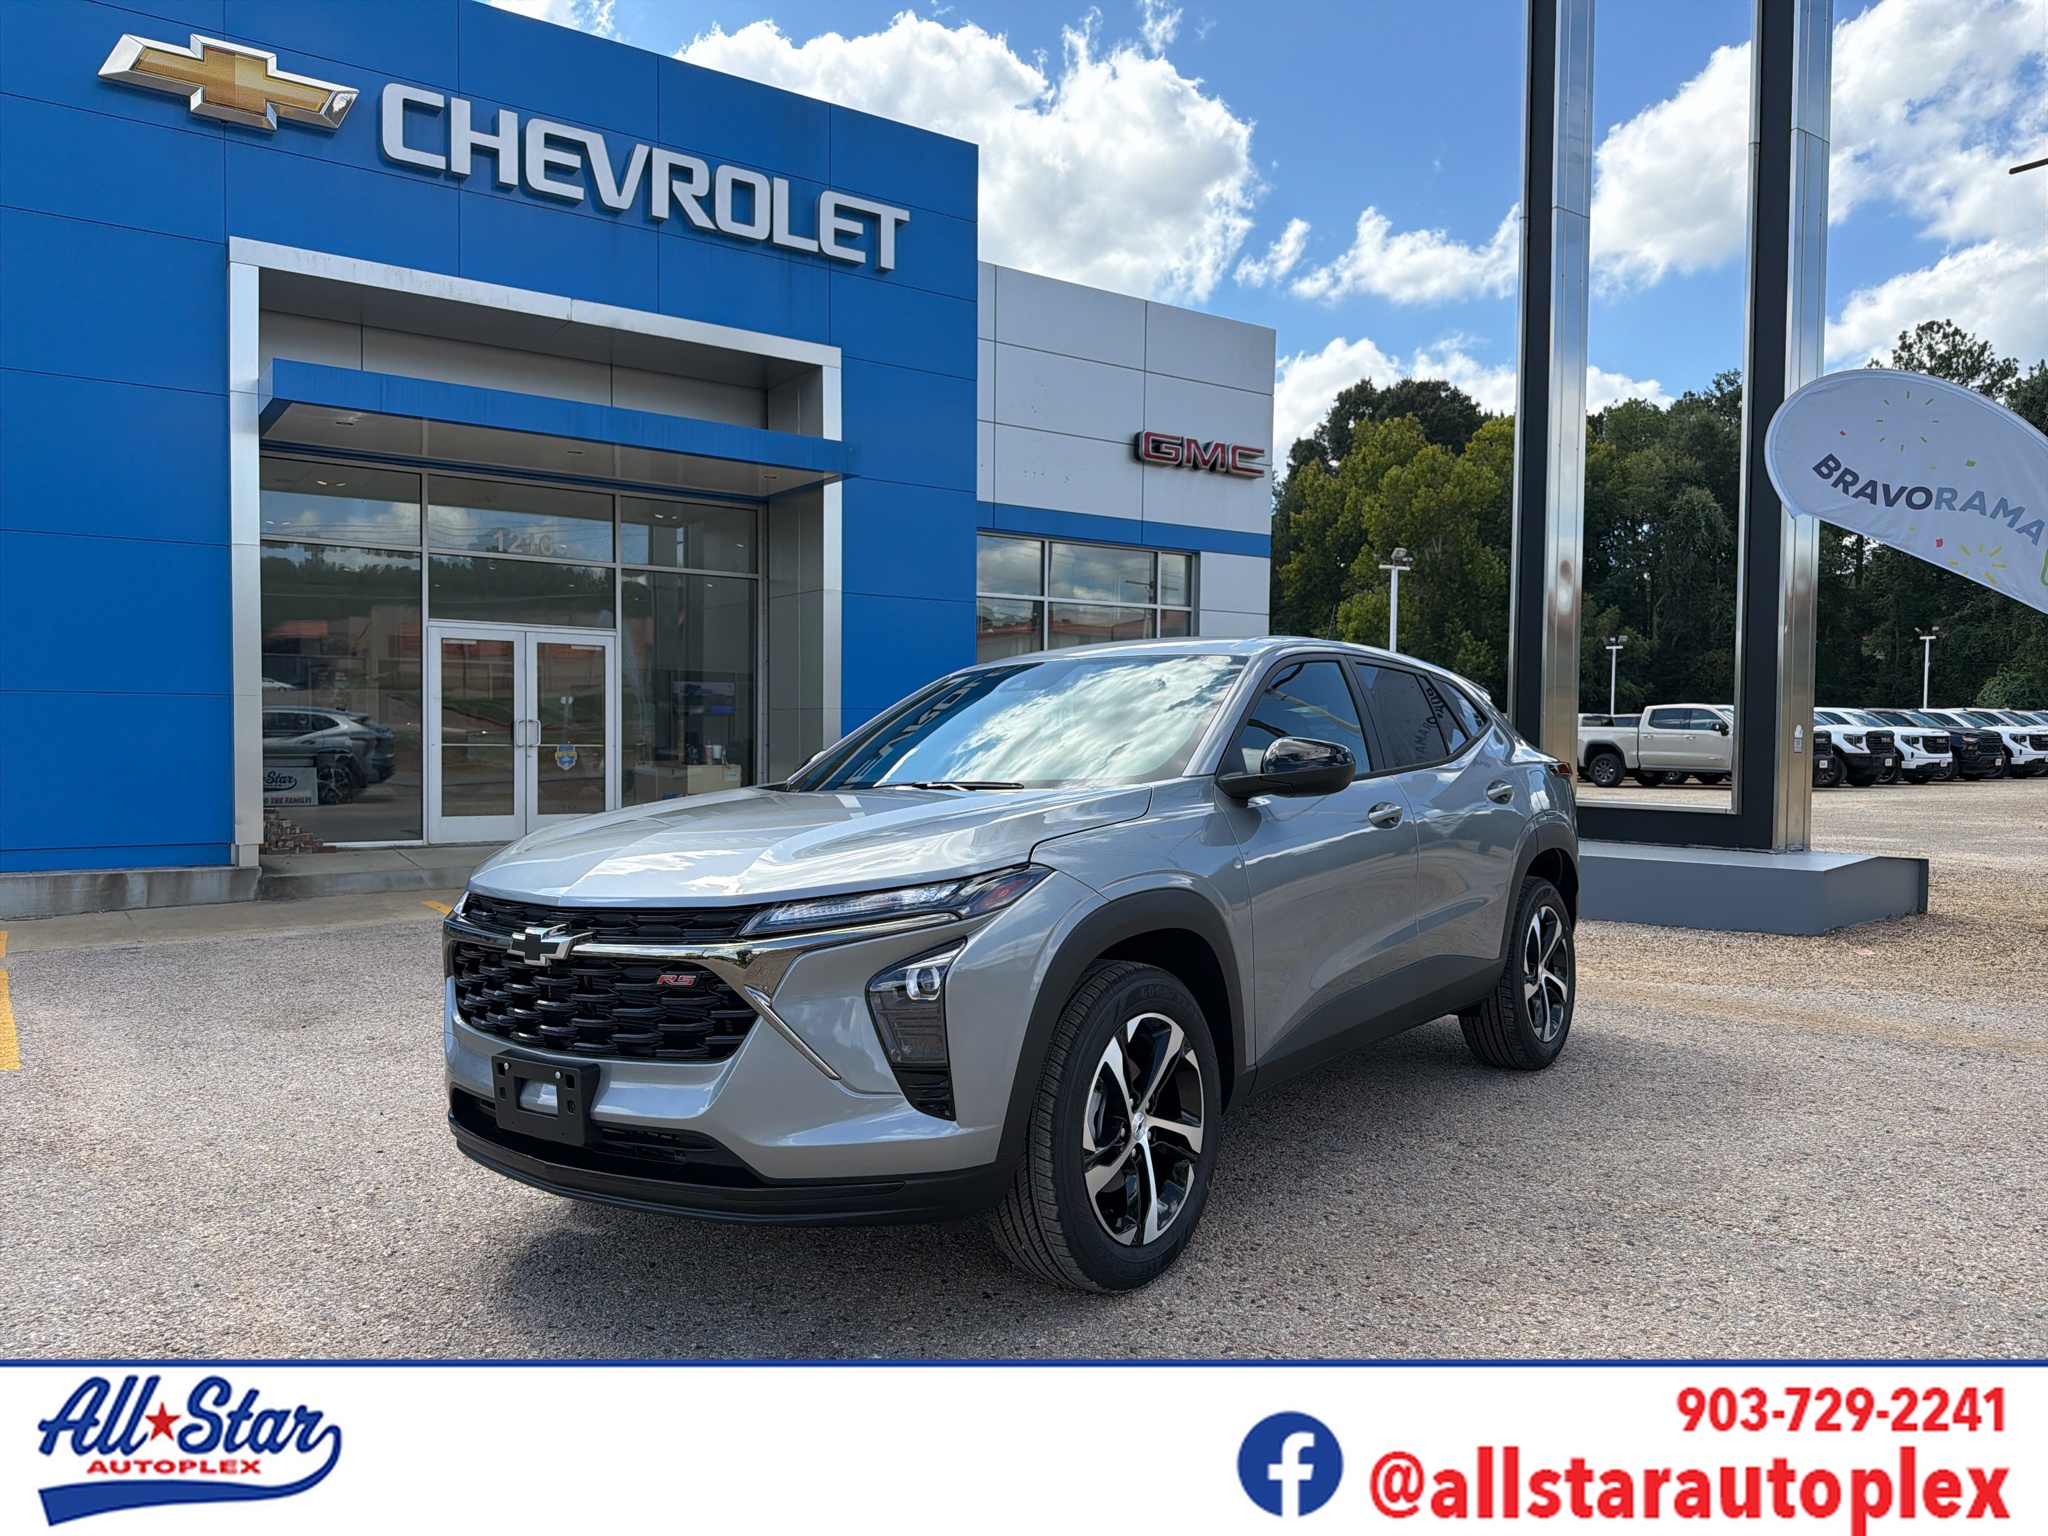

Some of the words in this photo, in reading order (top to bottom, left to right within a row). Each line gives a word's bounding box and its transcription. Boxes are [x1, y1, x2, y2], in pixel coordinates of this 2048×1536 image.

[380, 82, 911, 273] CHEVROLET
[1136, 430, 1266, 478] GMC
[1811, 452, 2046, 546] BRAVORAMA
[657, 974, 697, 986] RS
